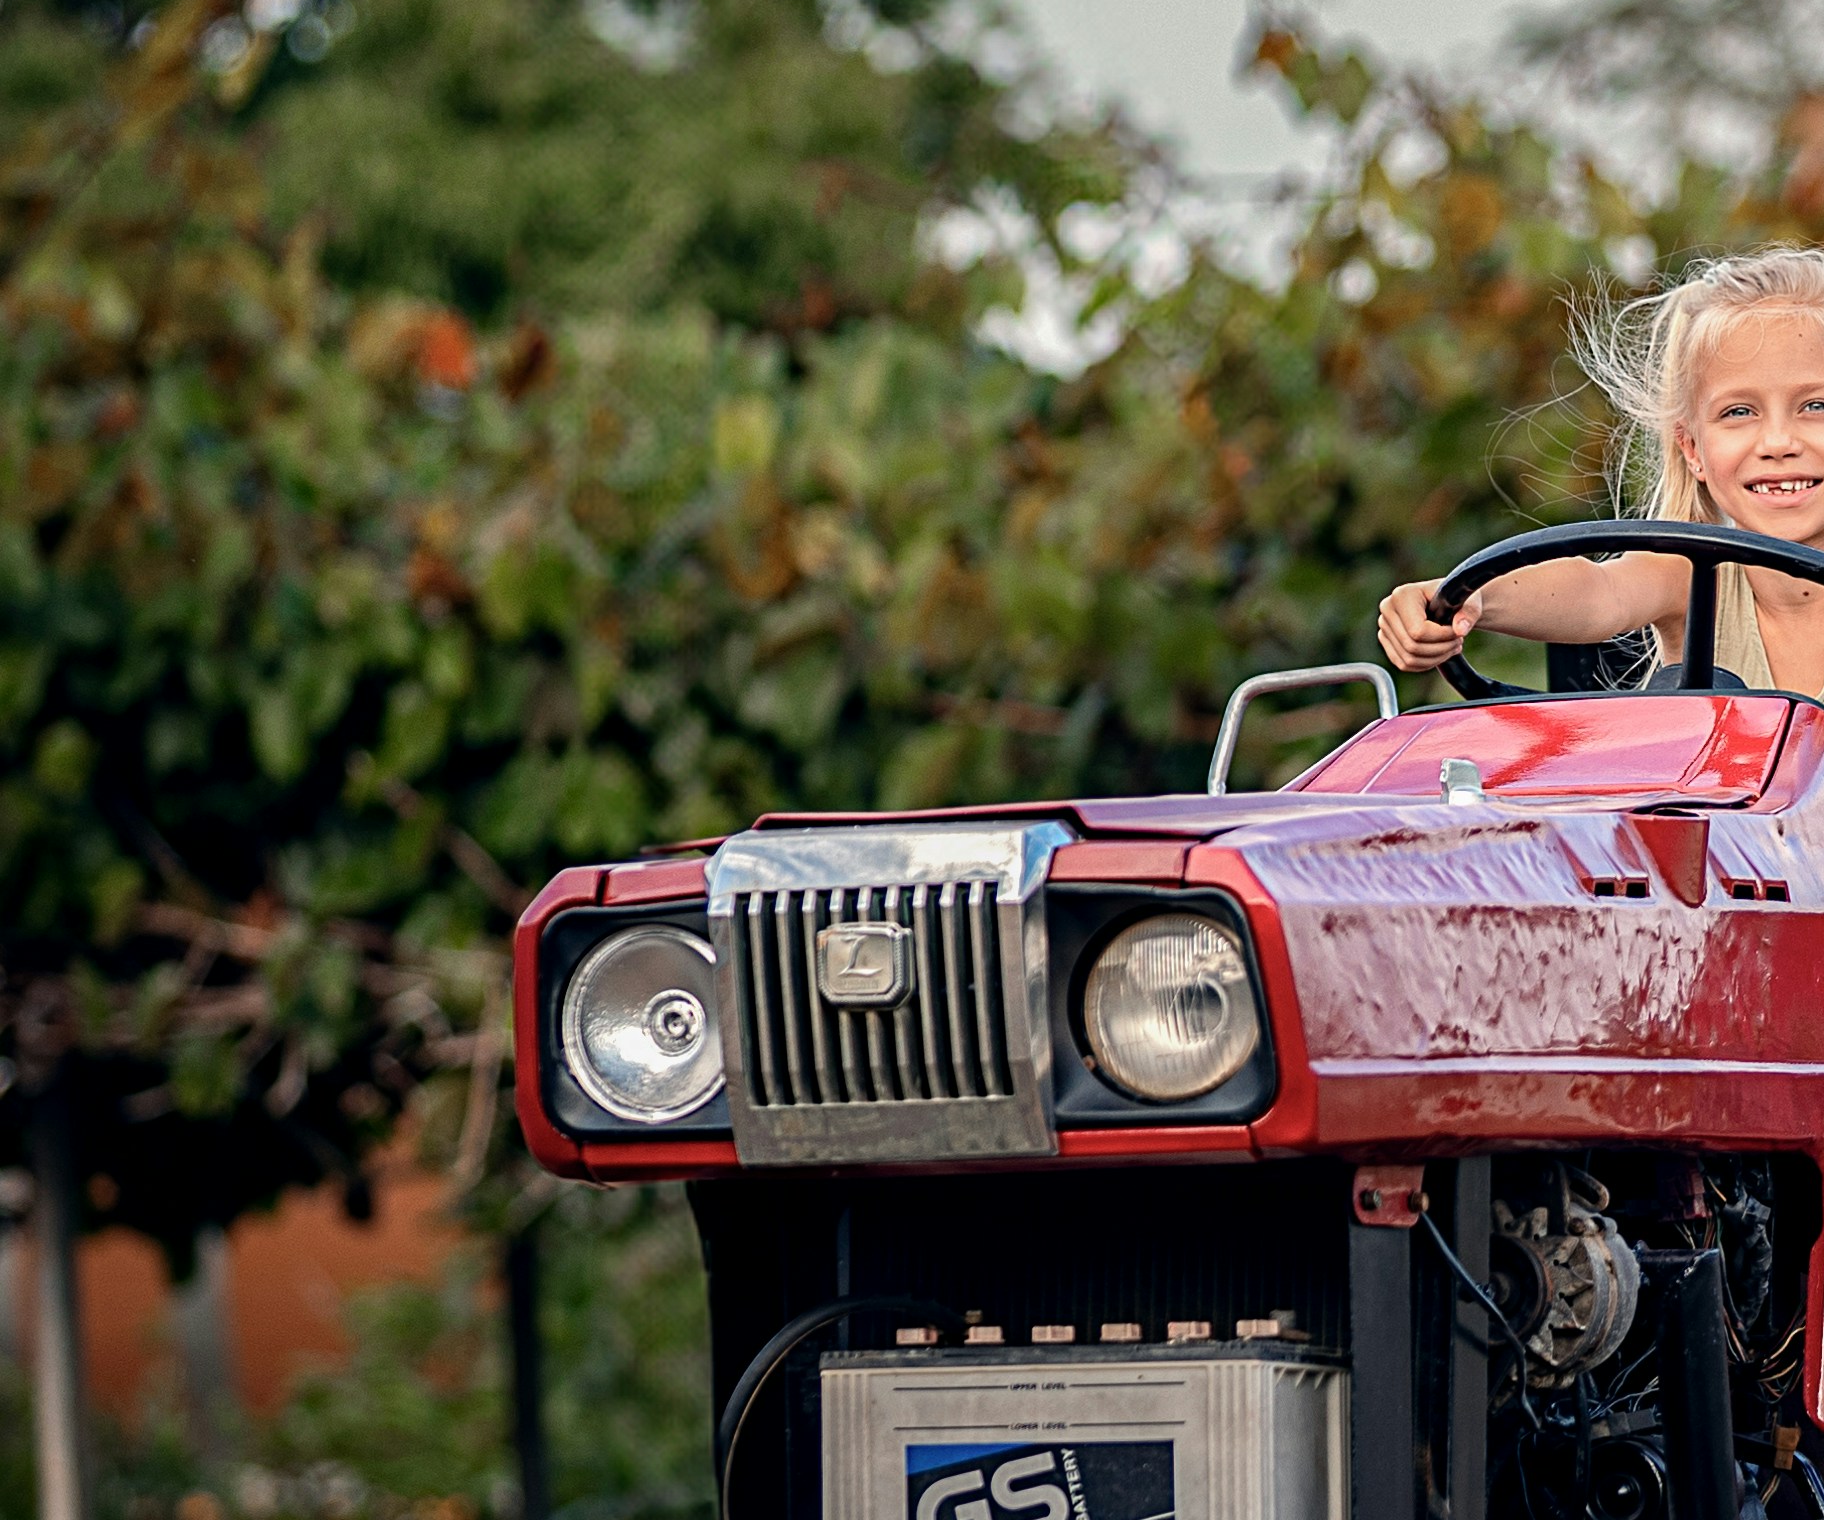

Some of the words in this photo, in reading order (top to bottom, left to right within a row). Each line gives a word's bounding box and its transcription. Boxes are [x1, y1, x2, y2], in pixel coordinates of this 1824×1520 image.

[1009, 1382, 1038, 1392] UPPER
[1041, 1381, 1066, 1391] LEVEL
[1009, 1421, 1039, 1430] LOWER
[1041, 1420, 1067, 1430] LEVEL
